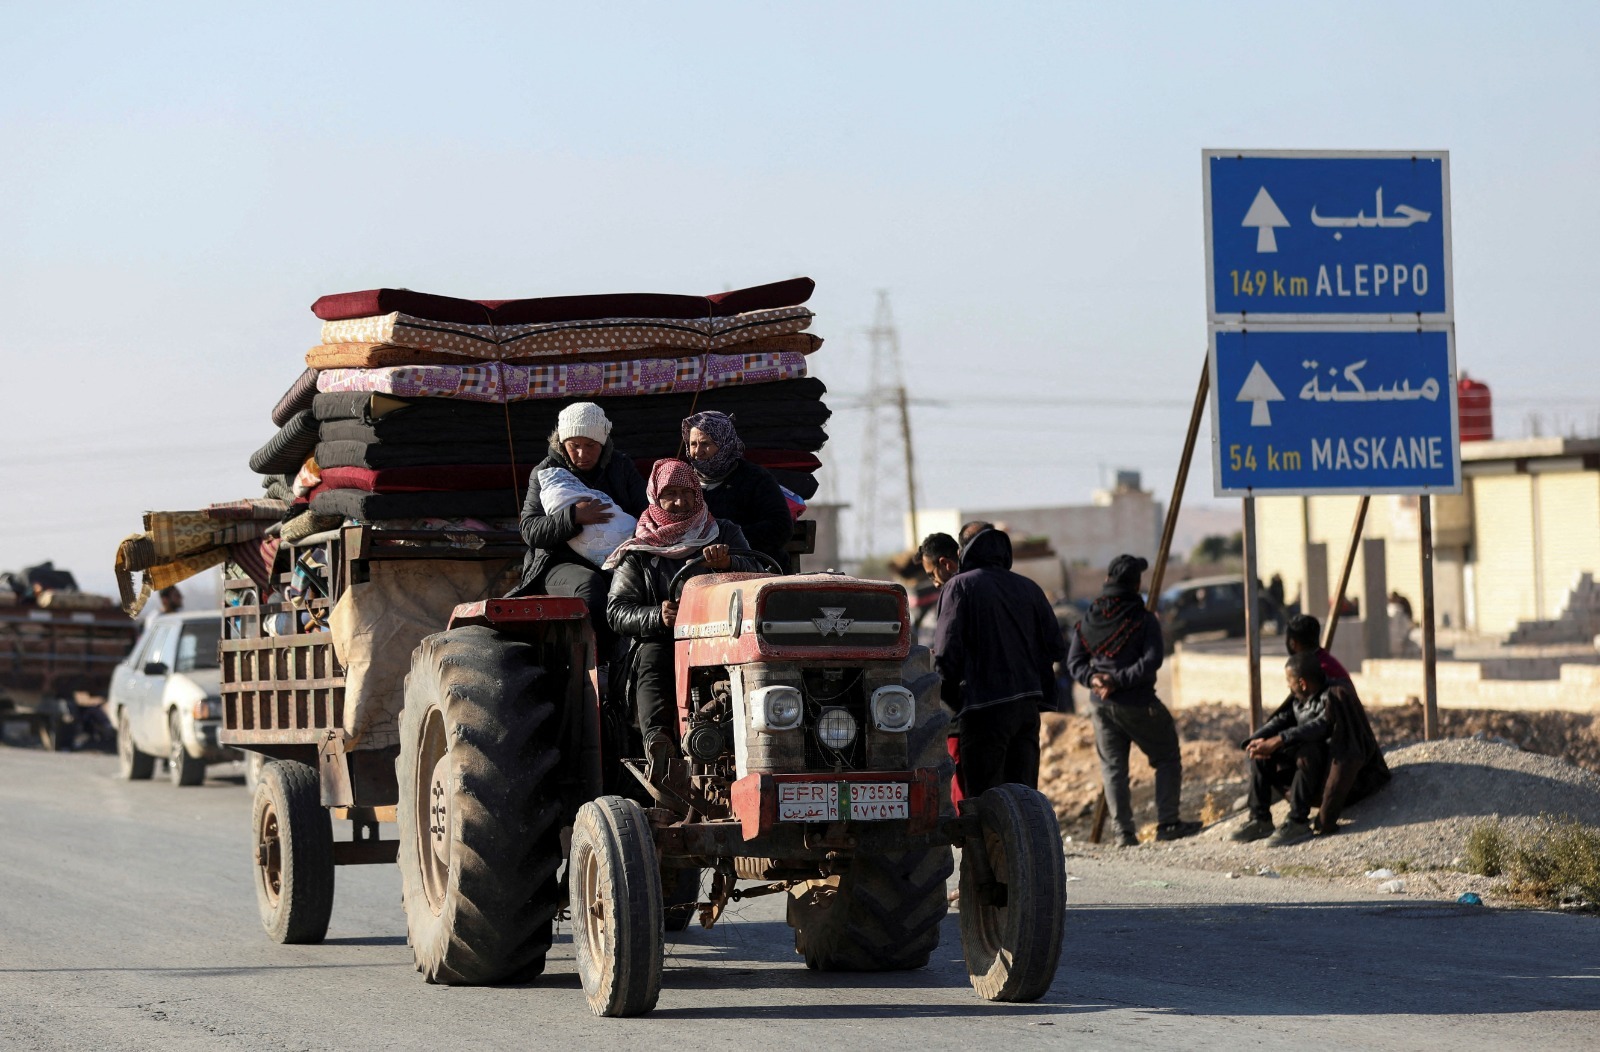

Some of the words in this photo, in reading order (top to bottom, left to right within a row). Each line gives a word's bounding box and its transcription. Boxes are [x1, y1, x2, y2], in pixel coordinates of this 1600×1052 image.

[1310, 185, 1432, 241] حلب
[1230, 270, 1267, 297] 149
[1273, 270, 1309, 297] km
[1315, 263, 1429, 297] ALEPPO
[1299, 359, 1440, 403] مسكنة
[1230, 445, 1257, 472] 54
[1267, 445, 1302, 472] km
[1311, 436, 1445, 471] MASKANE
[782, 786, 824, 801] EFR
[829, 786, 838, 817] SYR
[851, 785, 903, 801] 973536
[783, 806, 824, 819] عفرين
[853, 804, 905, 818] ٩٧٣٥٣٦
